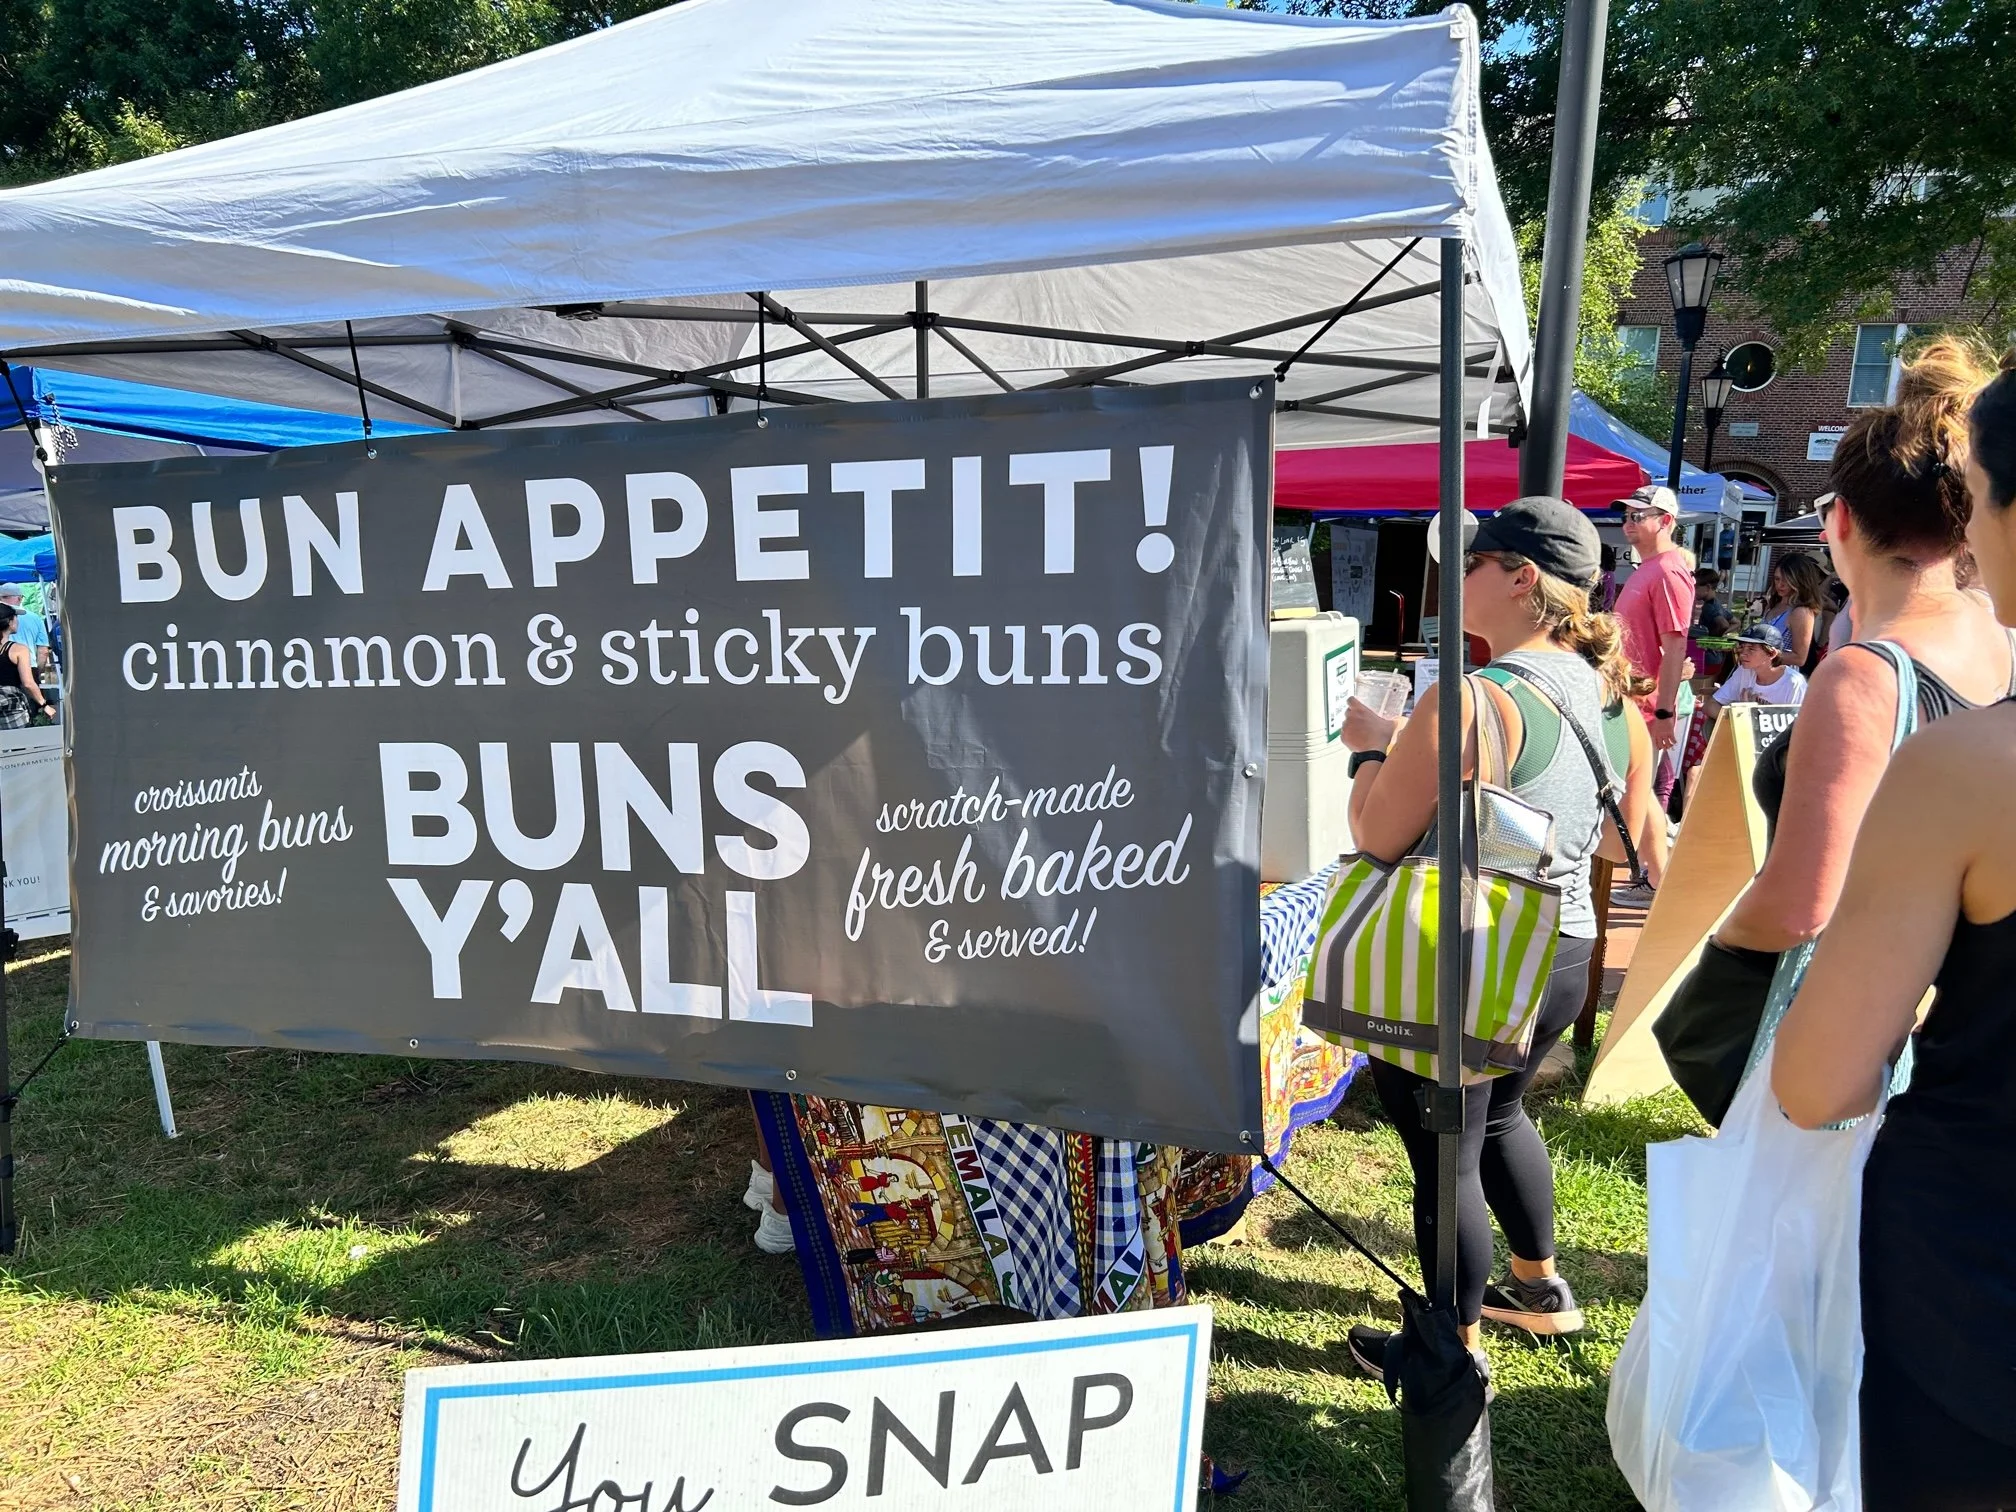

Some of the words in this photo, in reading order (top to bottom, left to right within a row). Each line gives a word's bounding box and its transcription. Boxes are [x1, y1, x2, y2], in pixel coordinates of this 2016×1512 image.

[113, 492, 363, 603] BUN
[422, 445, 1175, 592] APPETIT!
[1679, 485, 1706, 495] ther
[122, 623, 504, 691] cinnamon
[526, 613, 578, 686] &
[601, 607, 877, 705] sticky
[900, 606, 1163, 686] buns
[135, 765, 262, 814] croissants
[379, 741, 811, 881] BUNS
[876, 763, 1135, 833] scratch-made
[17, 876, 40, 886] YOU!
[100, 823, 249, 884] morning
[257, 799, 354, 853] buns
[845, 833, 986, 942] fresh
[1001, 812, 1193, 901] baked
[142, 885, 162, 922] &
[164, 867, 289, 919] savories!
[925, 919, 952, 964] &
[957, 907, 1098, 961] served!
[387, 877, 814, 1028] Y'ALL
[945, 1114, 1009, 1260] EMALA
[768, 1372, 1134, 1506] SNAP
